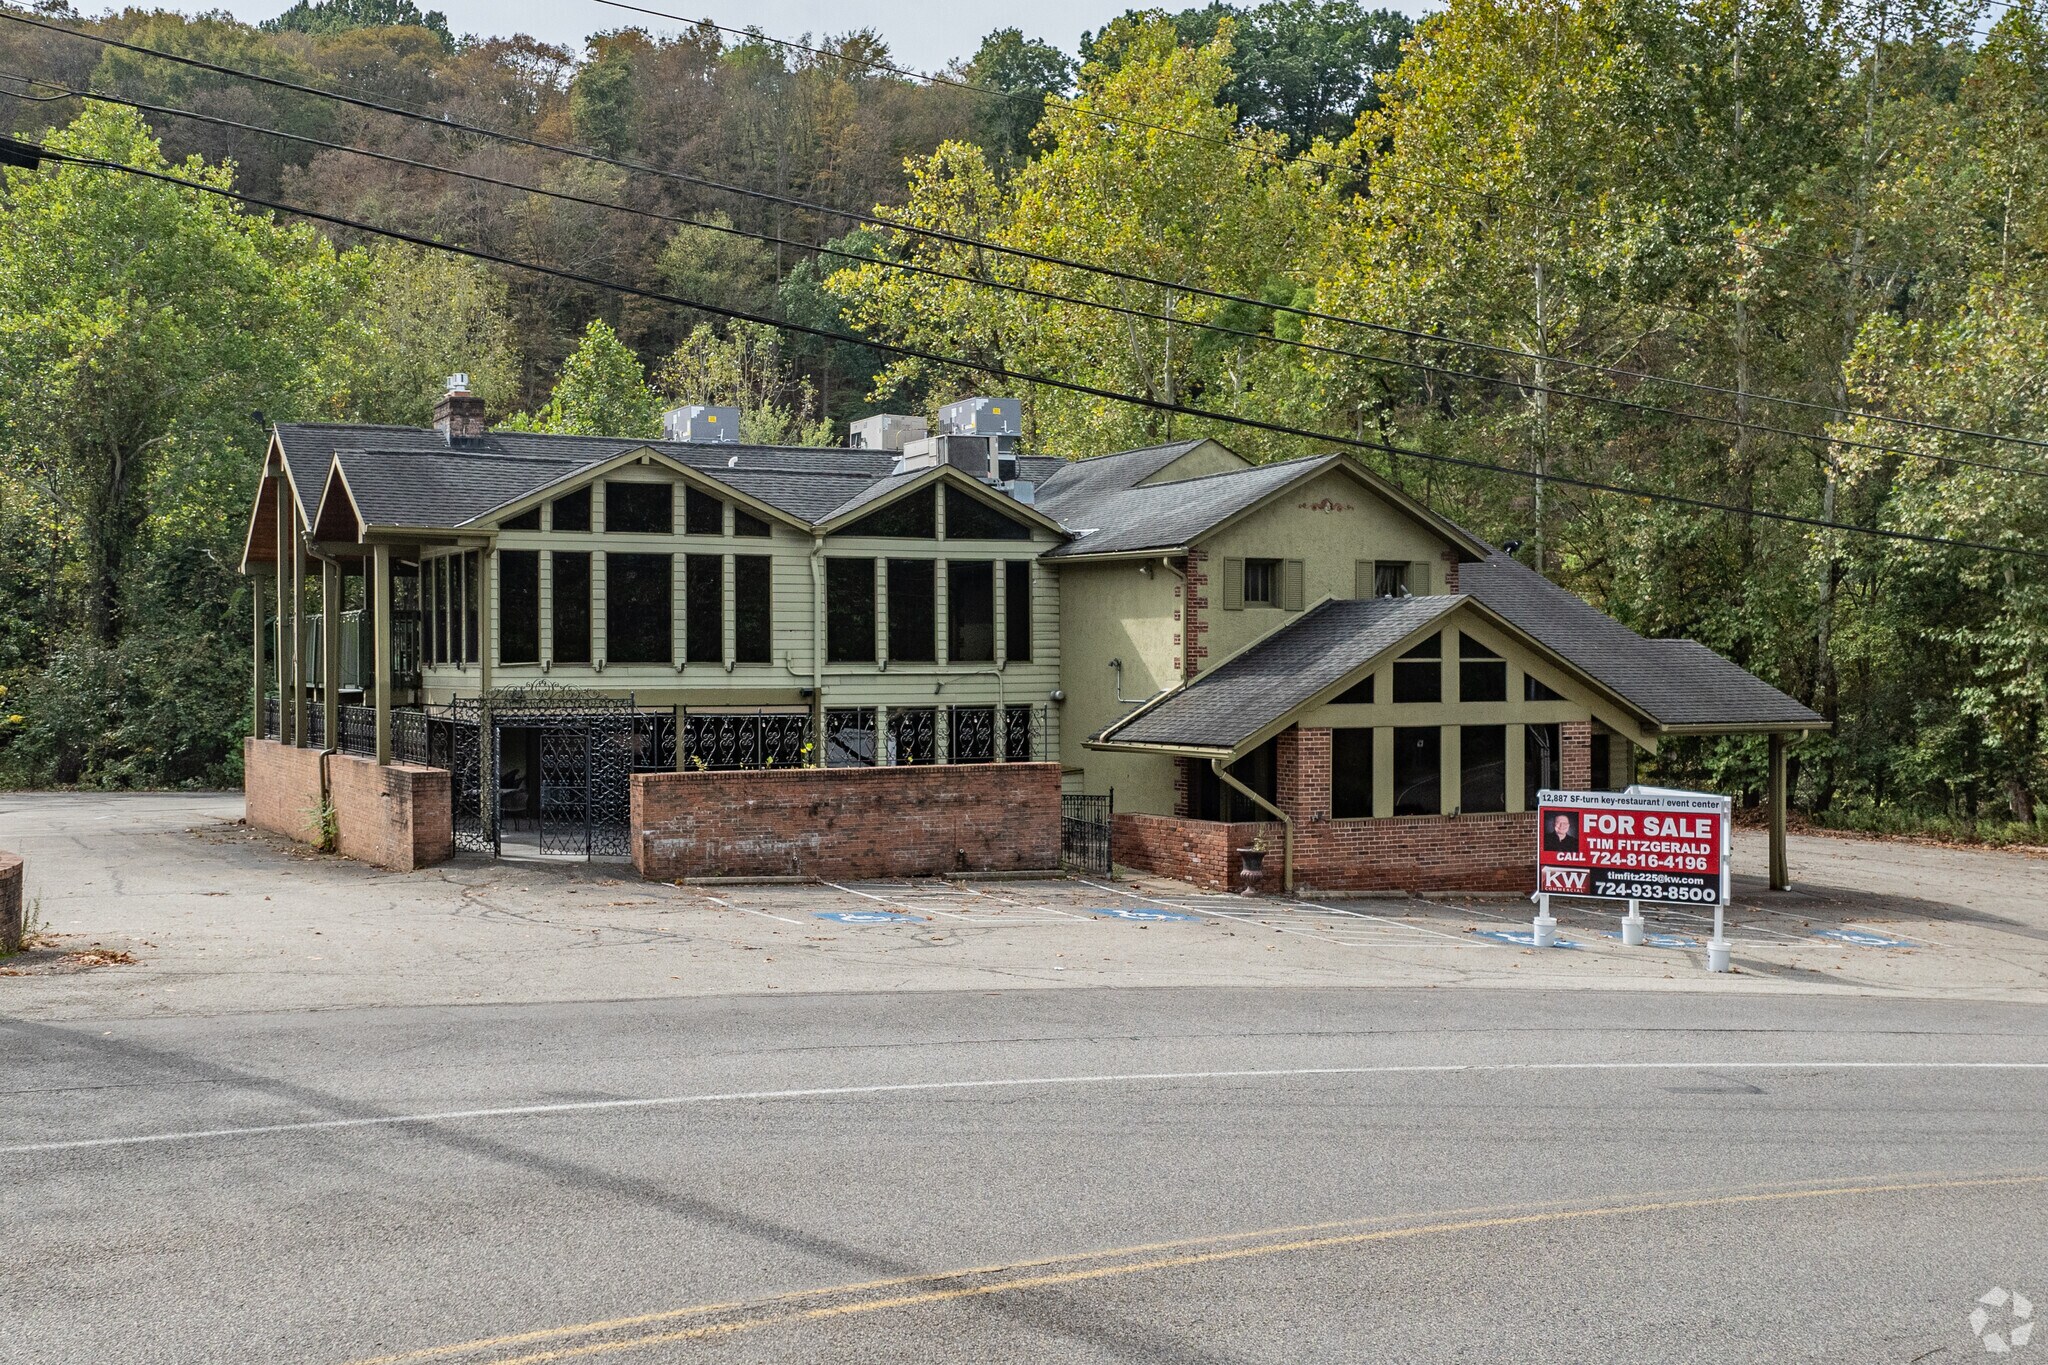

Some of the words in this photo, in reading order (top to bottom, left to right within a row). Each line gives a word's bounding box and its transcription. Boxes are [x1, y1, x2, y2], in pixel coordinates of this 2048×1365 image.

[1542, 794, 1567, 802] 12,887
[1570, 795, 1599, 804] SF-turn
[1601, 796, 1660, 806] key-restaurant
[1667, 800, 1690, 808] event
[1584, 814, 1635, 835] FOR
[1644, 816, 1712, 838] SALE
[1587, 838, 1614, 850] TIM
[1618, 840, 1710, 855] FITZGERALD
[1556, 852, 1586, 861] CALL
[1590, 852, 1708, 870] 724-816-4196
[1545, 870, 1588, 888] KW
[1608, 872, 1704, 885] timfitz225@kw.com
[1596, 882, 1716, 902] 724-933-8500
